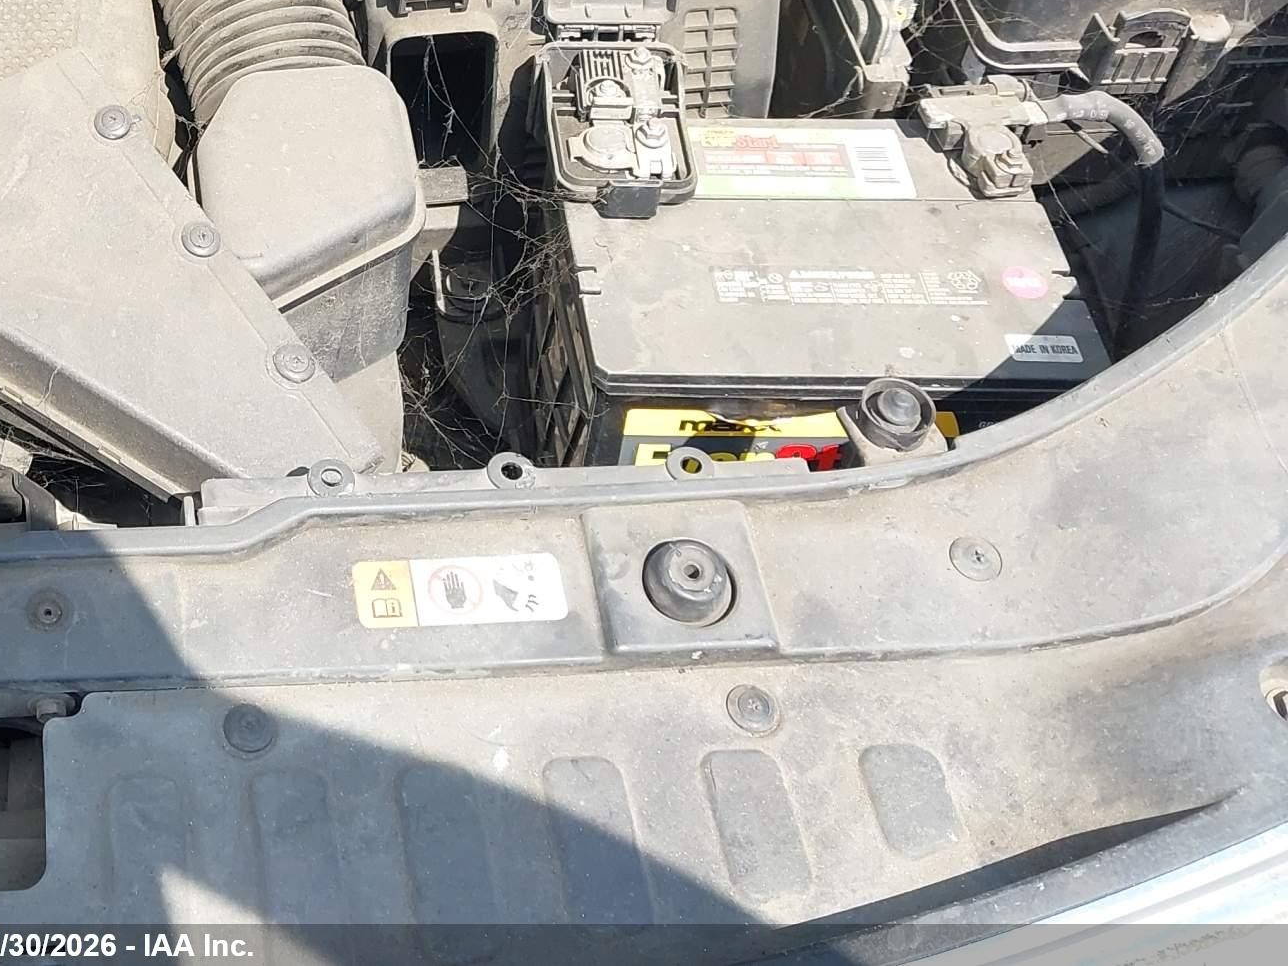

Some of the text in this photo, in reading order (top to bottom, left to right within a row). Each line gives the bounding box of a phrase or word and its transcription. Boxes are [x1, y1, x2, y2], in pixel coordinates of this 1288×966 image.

[1013, 344, 1079, 354] MADE IN KOREA
